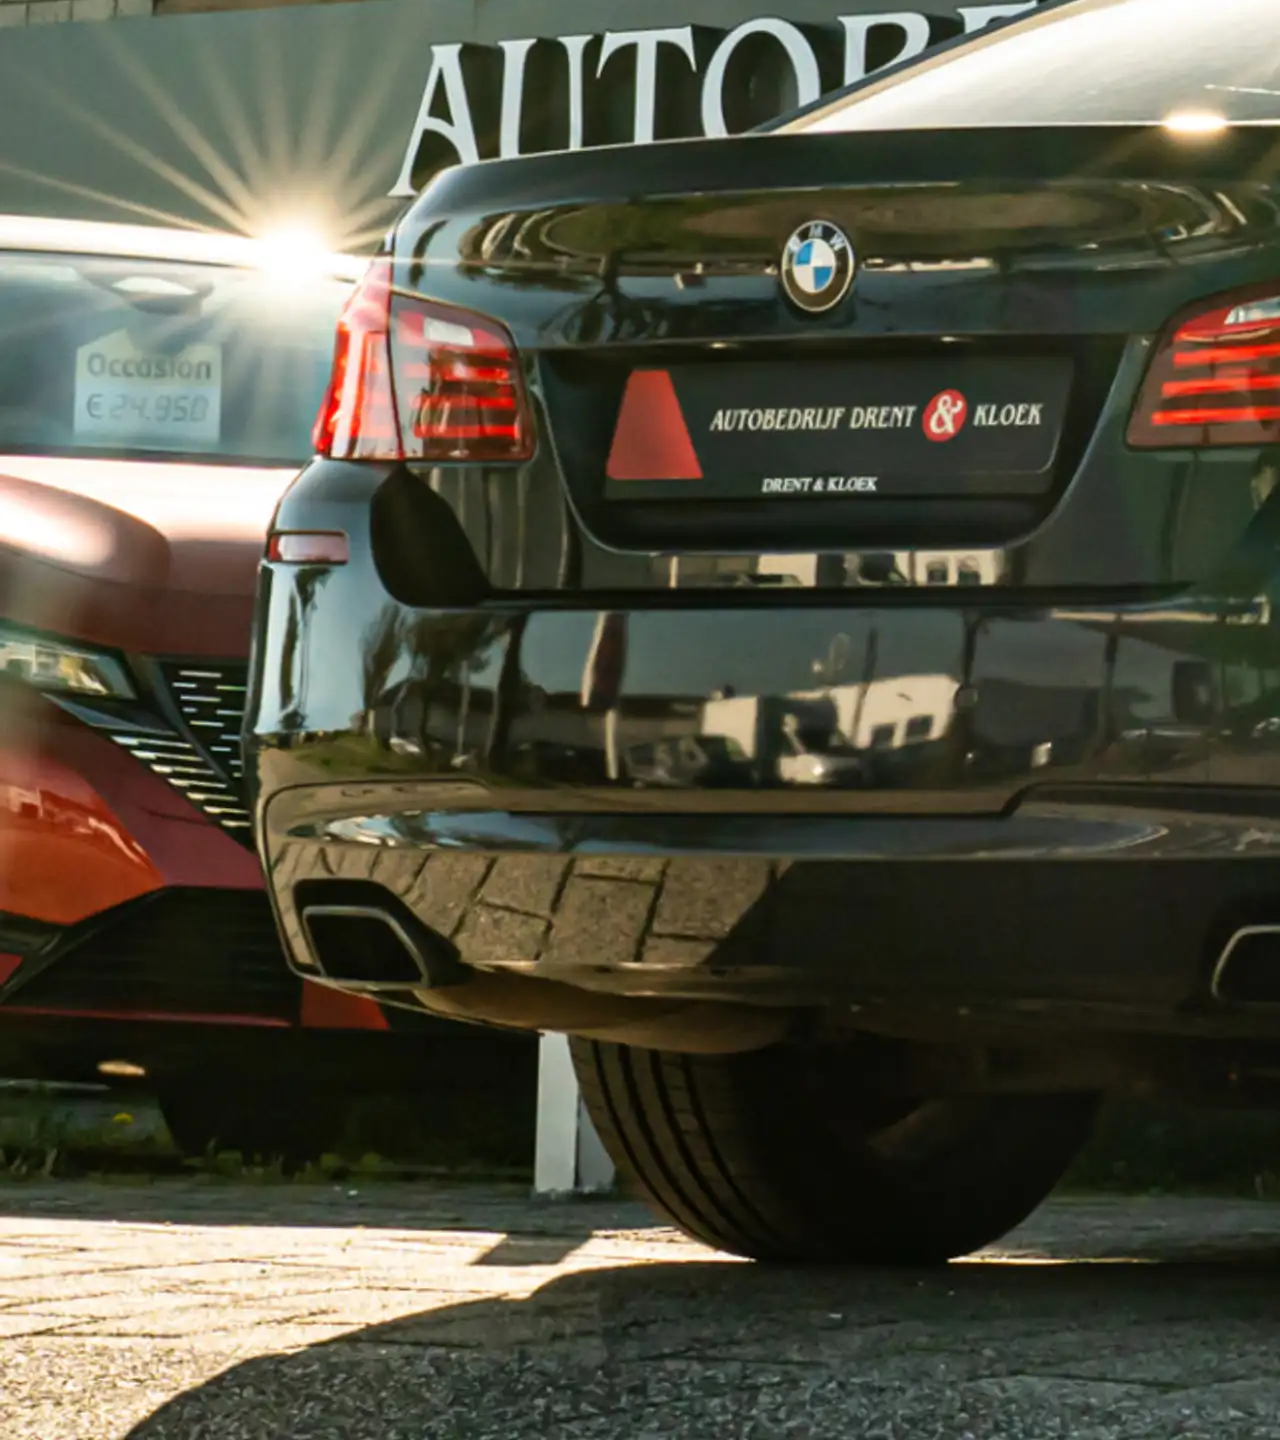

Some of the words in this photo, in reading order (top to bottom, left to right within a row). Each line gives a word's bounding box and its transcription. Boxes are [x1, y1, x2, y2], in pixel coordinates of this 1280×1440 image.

[86, 351, 213, 381] Occasion
[709, 406, 847, 432] AUTOBEDRIJF
[849, 404, 918, 430] DRENT
[928, 394, 964, 434] &
[972, 403, 1044, 427] KLOEK
[761, 477, 813, 493] DRENT
[826, 476, 878, 492] KLOEK
